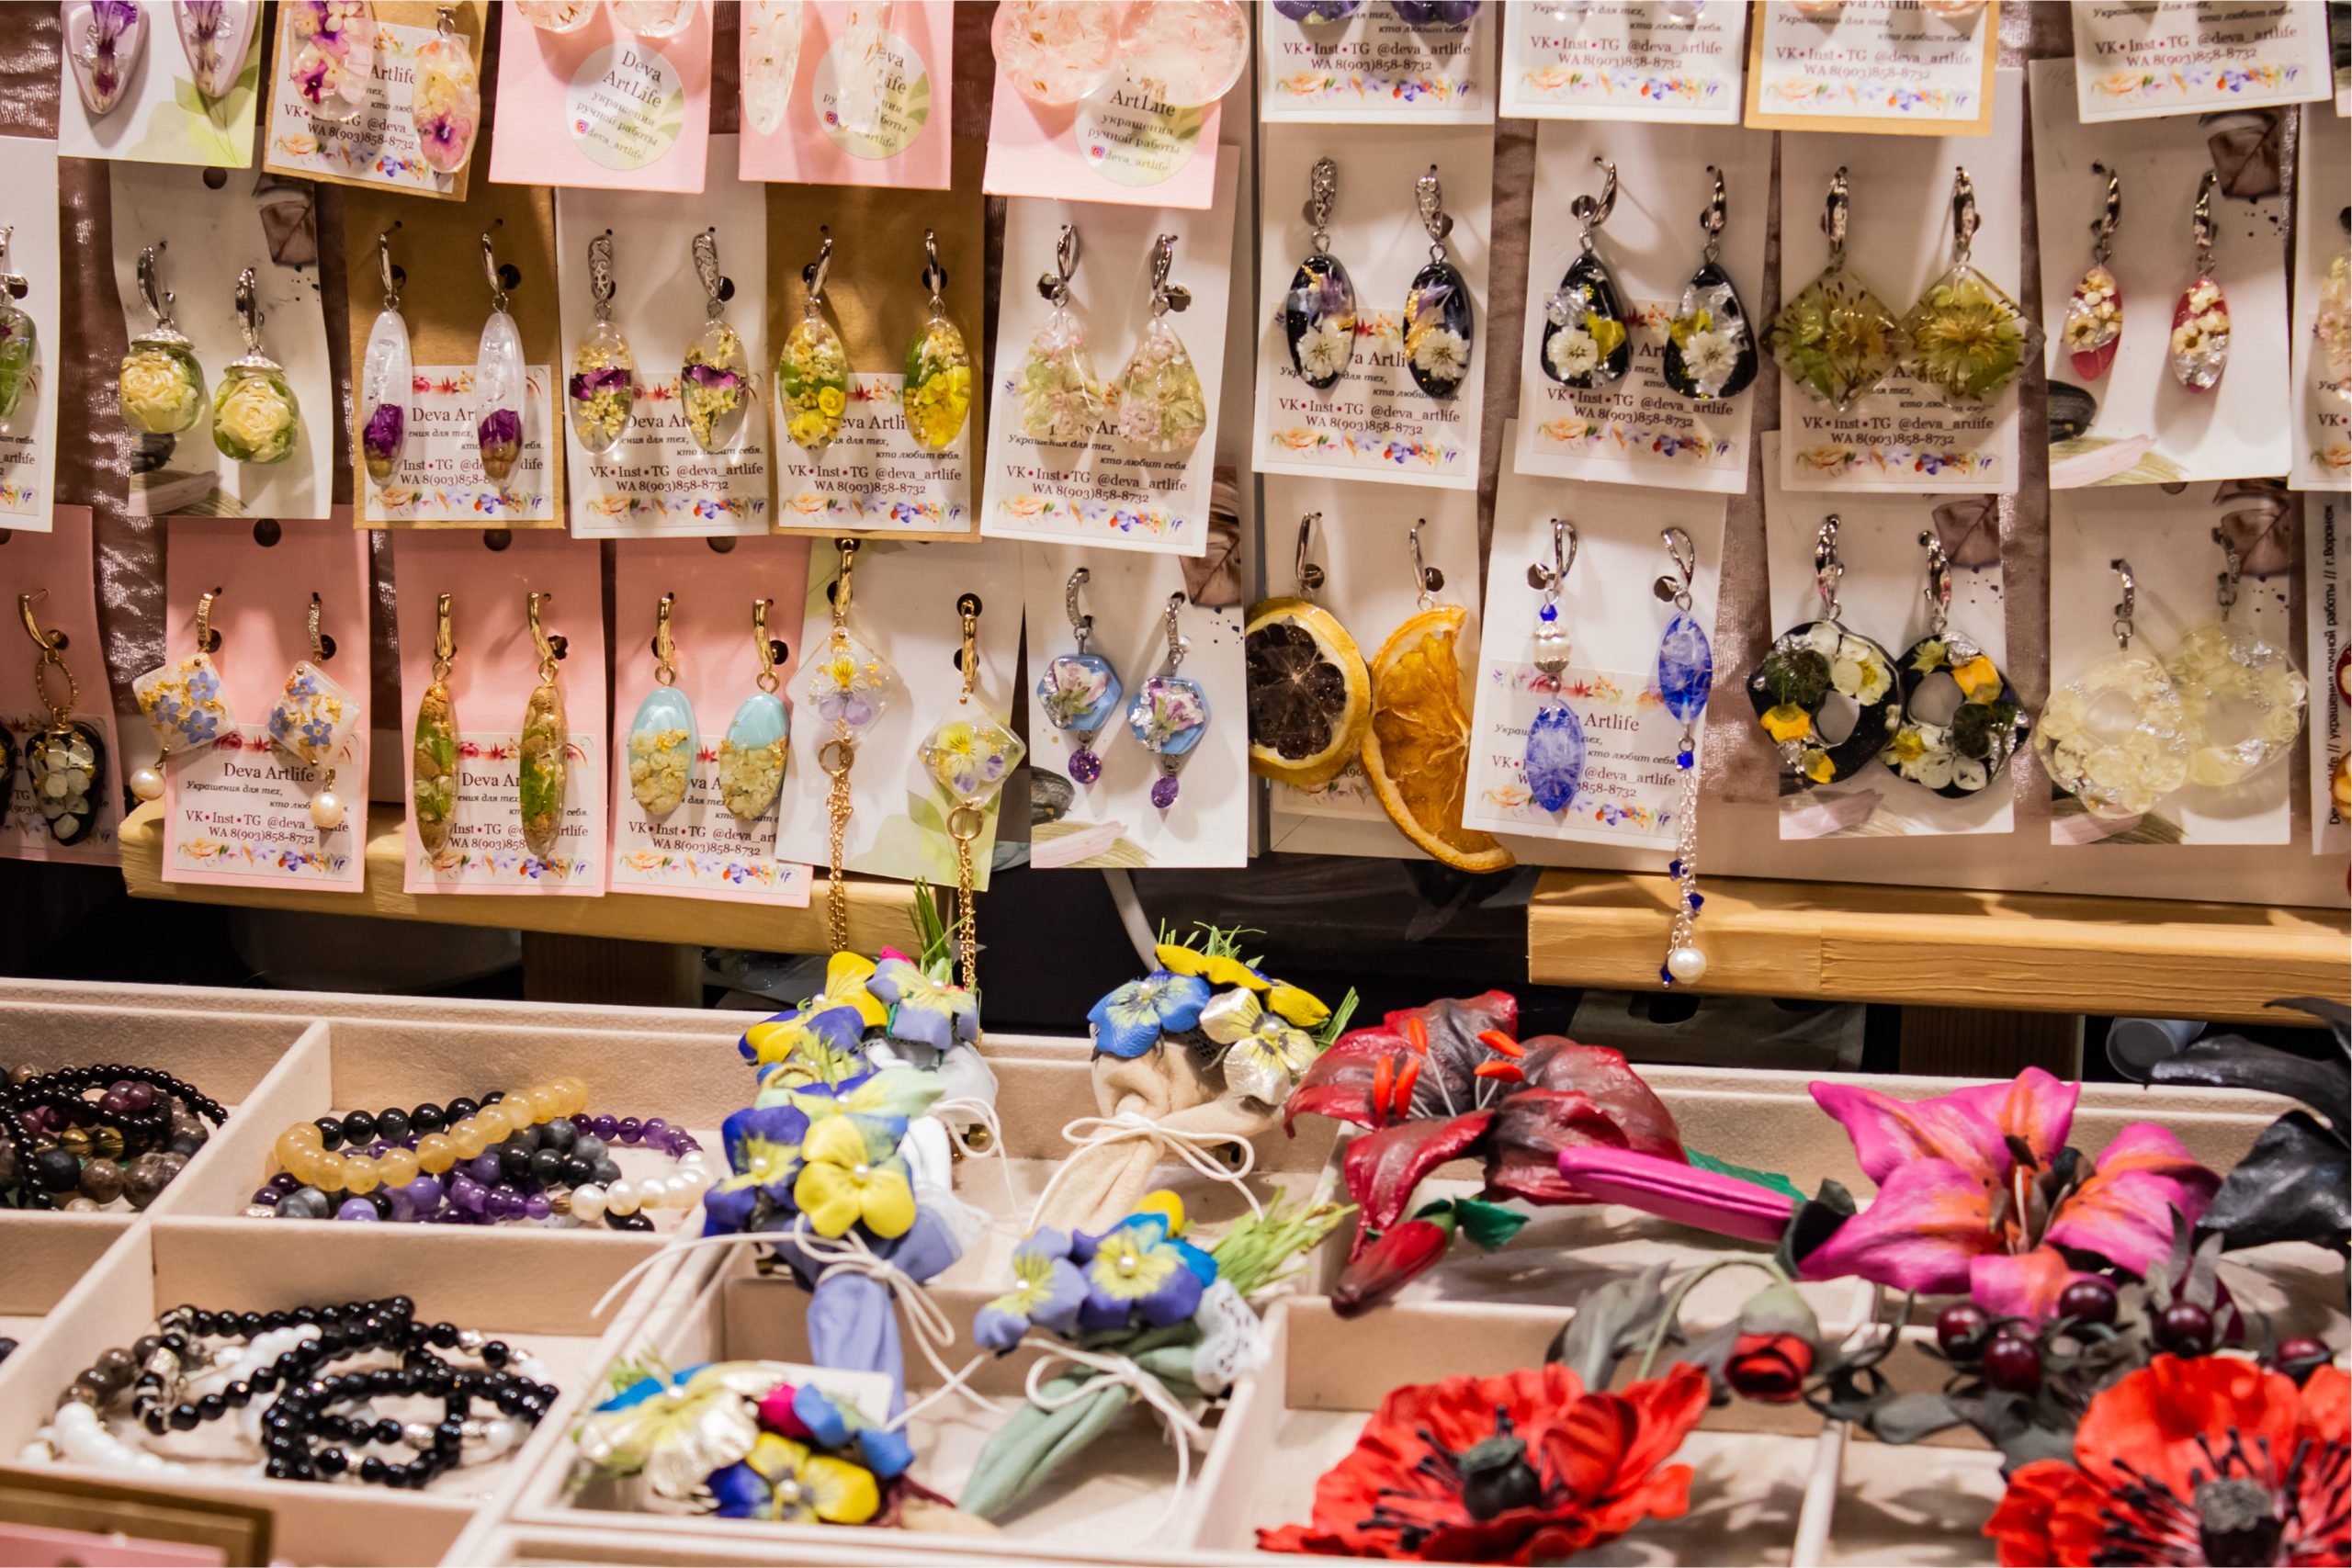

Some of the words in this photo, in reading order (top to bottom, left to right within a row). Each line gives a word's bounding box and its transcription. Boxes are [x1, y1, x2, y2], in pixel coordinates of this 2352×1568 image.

[1283, 43, 1303, 54] VK
[1315, 42, 1338, 54] Inst
[1351, 43, 1370, 54] TG
[1531, 37, 1551, 48] VK
[1563, 37, 1587, 50] Inst
[1600, 38, 1619, 50] TG
[620, 50, 662, 83] Deva
[1311, 59, 1332, 70] WA
[1336, 59, 1432, 72] 8(903)858-8732
[1558, 53, 1579, 64] WA
[1584, 54, 1682, 69] 8(903)858-8732
[603, 70, 662, 108] ArtLife
[284, 104, 302, 118] VK
[592, 91, 655, 127] украшения
[308, 123, 327, 137] WA
[576, 101, 616, 126] ручной
[617, 121, 658, 146] работы
[1102, 114, 1173, 136] украшения
[587, 128, 642, 161] deva_artlife
[1088, 128, 1134, 144] ручной
[1136, 139, 1180, 154] работы
[1105, 151, 1168, 172] deva_artlife
[1373, 388, 1395, 397] кто
[1547, 388, 1567, 400] VK
[1577, 390, 1601, 403] Inst
[1614, 394, 1634, 406] TG
[1280, 398, 1299, 411] VK
[1309, 400, 1333, 412] Inst
[1345, 403, 1363, 414] TG
[413, 408, 450, 422] Deva
[1575, 407, 1594, 418] WA
[1599, 408, 1693, 427] 8(903)858-8732
[1306, 416, 1327, 427] WA
[1330, 417, 1423, 434] 8(903)858-8732
[433, 428, 449, 438] для
[452, 430, 473, 438] тех,
[647, 435, 663, 445] для
[1831, 434, 1852, 444] WA
[847, 436, 864, 445] для
[866, 438, 889, 446] тех,
[739, 446, 763, 455] себя.
[938, 451, 962, 459] себя.
[403, 459, 425, 470] Inst
[435, 459, 453, 470] TG
[1100, 457, 1122, 465] кто
[1125, 459, 1161, 468] любит
[590, 467, 609, 477] VK
[618, 467, 641, 477] Inst
[650, 466, 670, 477] TG
[788, 465, 807, 477] VK
[817, 466, 840, 477] Inst
[850, 466, 868, 478] TG
[1006, 466, 1026, 478] VK
[1036, 468, 1060, 480] Inst
[1070, 470, 1090, 482] TG
[401, 475, 420, 484] WA
[616, 481, 636, 491] WA
[639, 480, 729, 493] 8(903)858-8732
[815, 480, 834, 491] WA
[837, 481, 926, 495] 8(903)858-8732
[1033, 483, 1053, 494] WA
[1057, 485, 1148, 503] 8(903)858-8732
[2324, 583, 2338, 626] работы
[1584, 713, 1639, 731] Artlife
[1588, 750, 1610, 759] кто
[1612, 752, 1650, 762] любит
[224, 762, 261, 778] Deva
[266, 766, 314, 782] Artlife
[1492, 756, 1511, 769] VK
[1584, 766, 1676, 786] @deva_artlife
[462, 773, 499, 786] Deva
[187, 781, 240, 793] Украшения
[243, 784, 259, 794] для
[262, 787, 283, 796] тех,
[269, 800, 289, 808] кто
[481, 794, 497, 802] для
[186, 810, 204, 821] VK
[213, 812, 234, 824] Inst
[244, 815, 261, 826] TG
[453, 823, 474, 834] Inst
[484, 824, 501, 834] TG
[628, 821, 647, 833] VK
[656, 823, 678, 835] Inst
[688, 826, 706, 837] TG
[209, 827, 228, 837] WA
[231, 829, 314, 845] 8(903)858-8732
[450, 839, 469, 848] WA
[653, 838, 671, 850] WA
[674, 840, 760, 856] 8(903)858-8732
